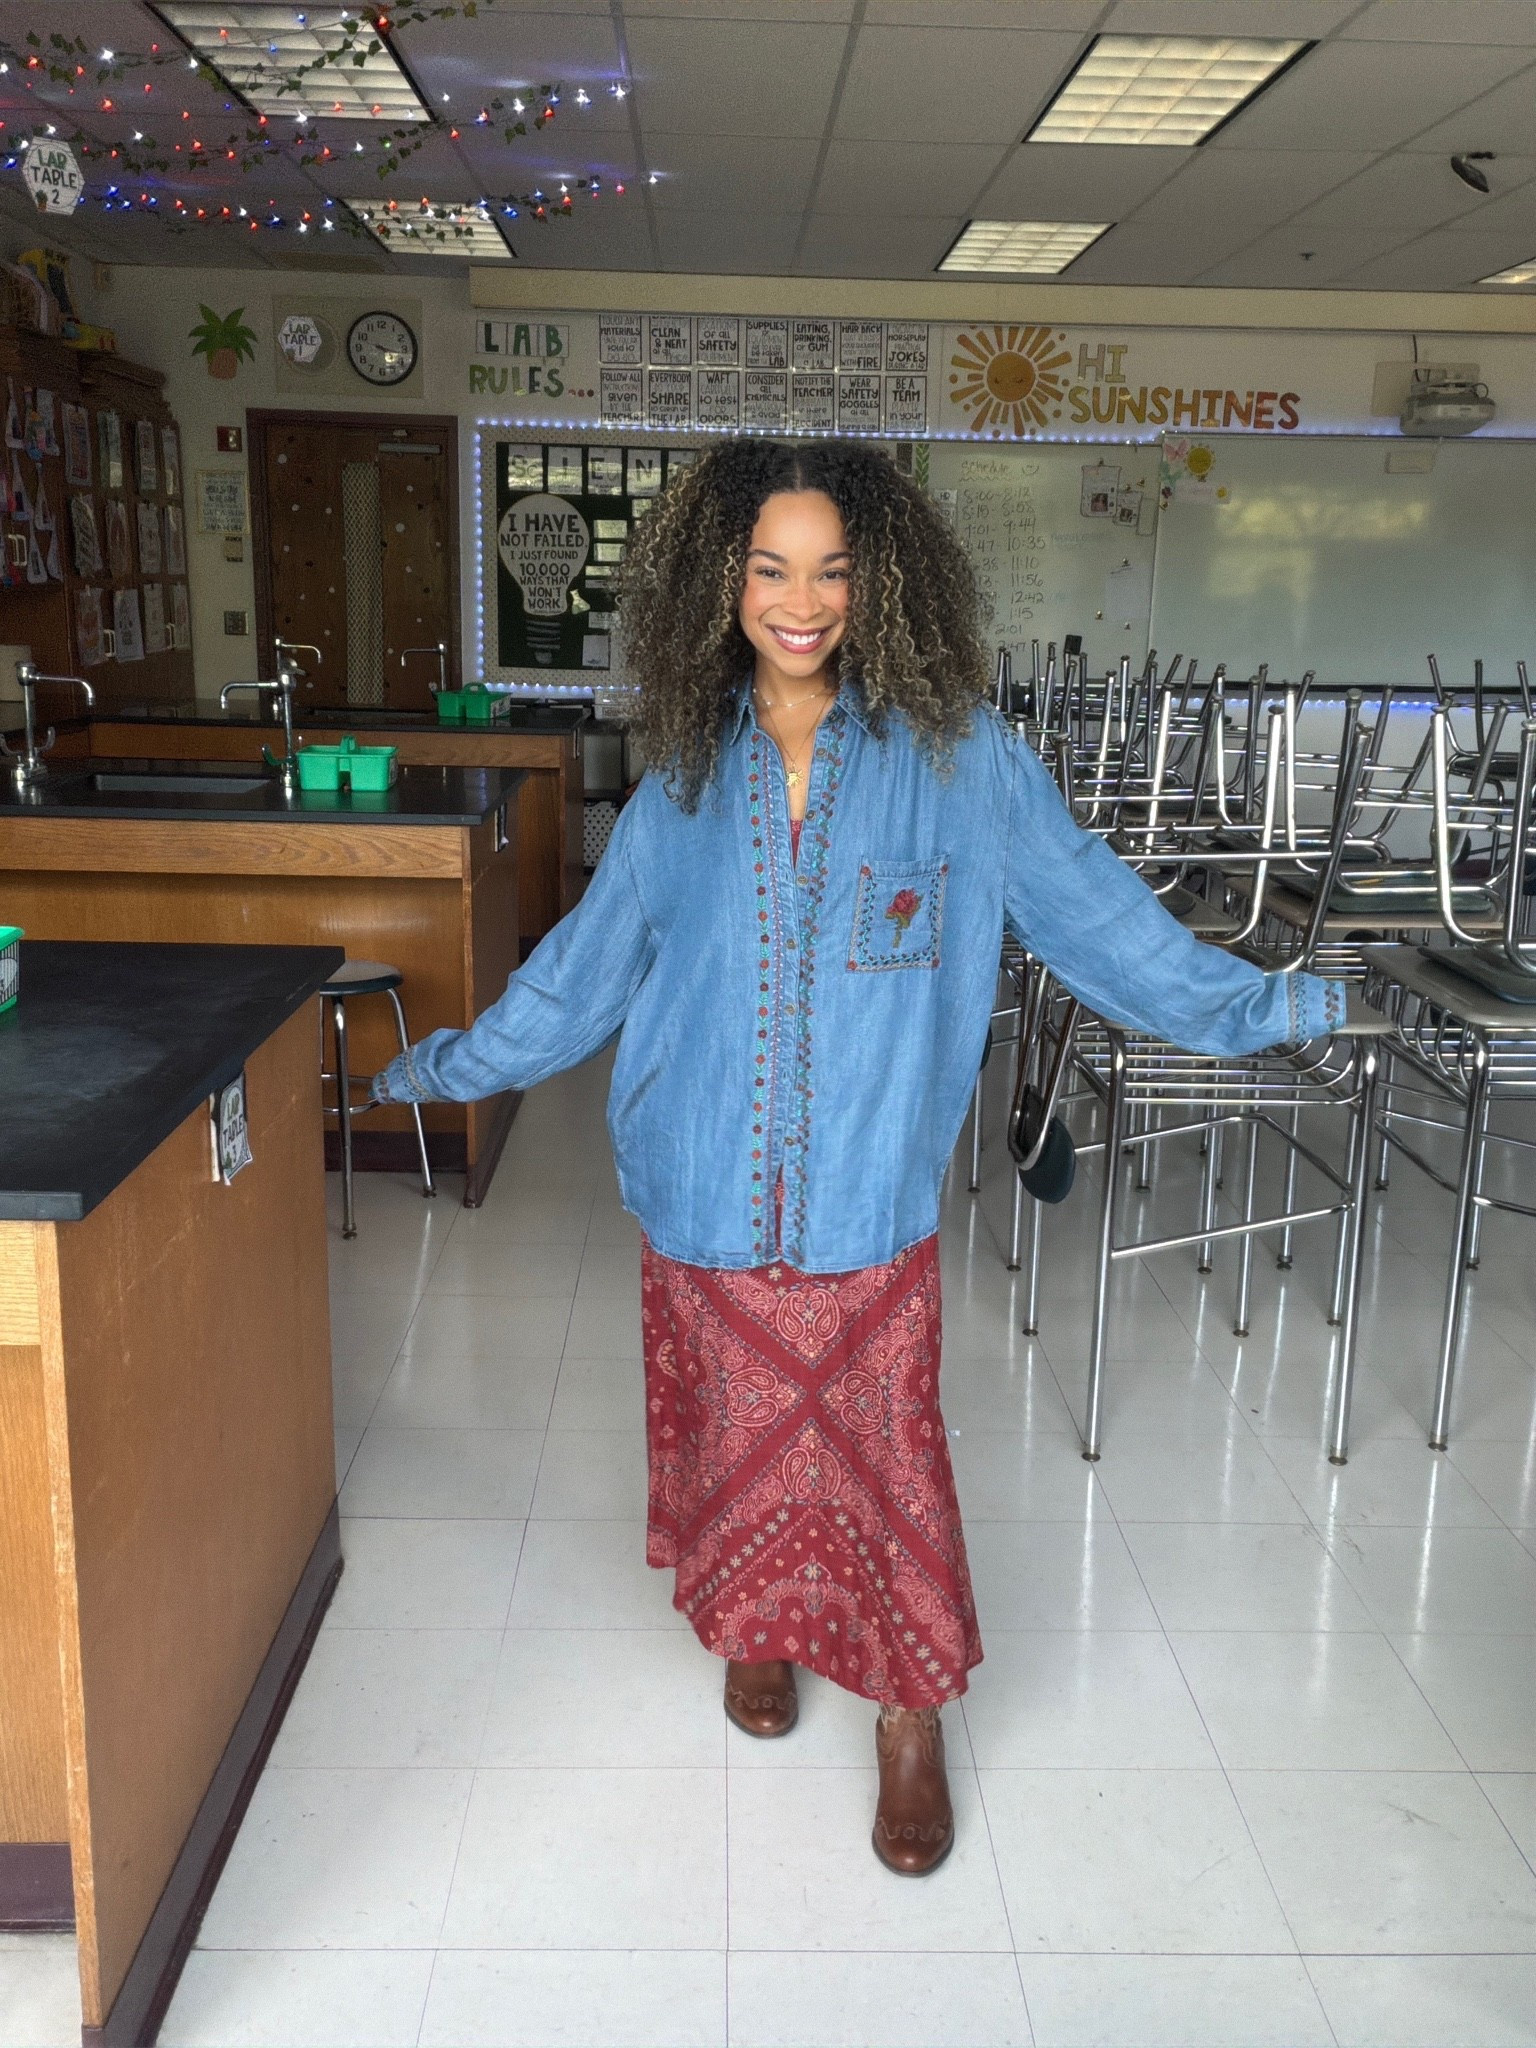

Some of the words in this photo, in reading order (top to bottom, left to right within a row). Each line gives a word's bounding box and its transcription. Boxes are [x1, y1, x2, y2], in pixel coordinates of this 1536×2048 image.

[37, 148, 67, 170] LAB
[30, 166, 78, 189] TABLE
[52, 188, 60, 204] 2
[289, 323, 310, 335] LAB
[366, 323, 375, 332] 11
[377, 320, 387, 329] 12
[841, 325, 859, 333] HAIR
[861, 325, 881, 334] BACK
[357, 332, 368, 341] 10
[600, 327, 640, 336] MATERIALS
[651, 328, 681, 337] CLEAN
[283, 333, 317, 346] TABLE
[484, 323, 563, 357] LAB
[665, 338, 687, 349] NEAT
[699, 340, 737, 351] SAFETY
[808, 343, 828, 351] GUM
[769, 357, 784, 367] LAB
[888, 351, 926, 363] JOKES
[1077, 343, 1128, 383] HI
[601, 372, 627, 381] FOLLOW
[628, 372, 641, 381] ALL
[650, 373, 690, 383] EVERYBODY
[707, 372, 730, 384] WAFT
[748, 375, 784, 385] CONSIDER
[849, 378, 871, 387] WEAR
[896, 378, 906, 389] BE
[910, 378, 915, 390] A
[608, 392, 637, 402] given
[650, 392, 689, 405] SHARE
[794, 388, 833, 397] TEACHER
[841, 389, 878, 399] SAFETY
[892, 390, 920, 402] TEAM
[716, 395, 737, 405] test
[1068, 386, 1301, 430] SUNSHINES
[700, 414, 736, 424] ODORS
[635, 459, 653, 482] N
[508, 513, 517, 532] I
[525, 513, 580, 532] HAVE
[1002, 517, 1036, 535] 9:44
[500, 533, 529, 547] NOT
[534, 534, 588, 548] FAILED.
[1007, 536, 1046, 552] 10:35
[510, 550, 515, 559] I
[518, 550, 542, 560] JUST
[544, 550, 579, 560] FOUND
[1011, 555, 1040, 571] 11:10
[520, 563, 570, 577] 10,000
[520, 576, 544, 585] WAYS
[546, 576, 570, 585] THAT
[1011, 572, 1044, 588] 11:56
[528, 587, 562, 598] WON'T
[1011, 591, 1044, 605] 12:42
[1010, 607, 1033, 620] 1:15
[995, 622, 1022, 635] 2:01
[223, 1114, 243, 1149] TABLE
